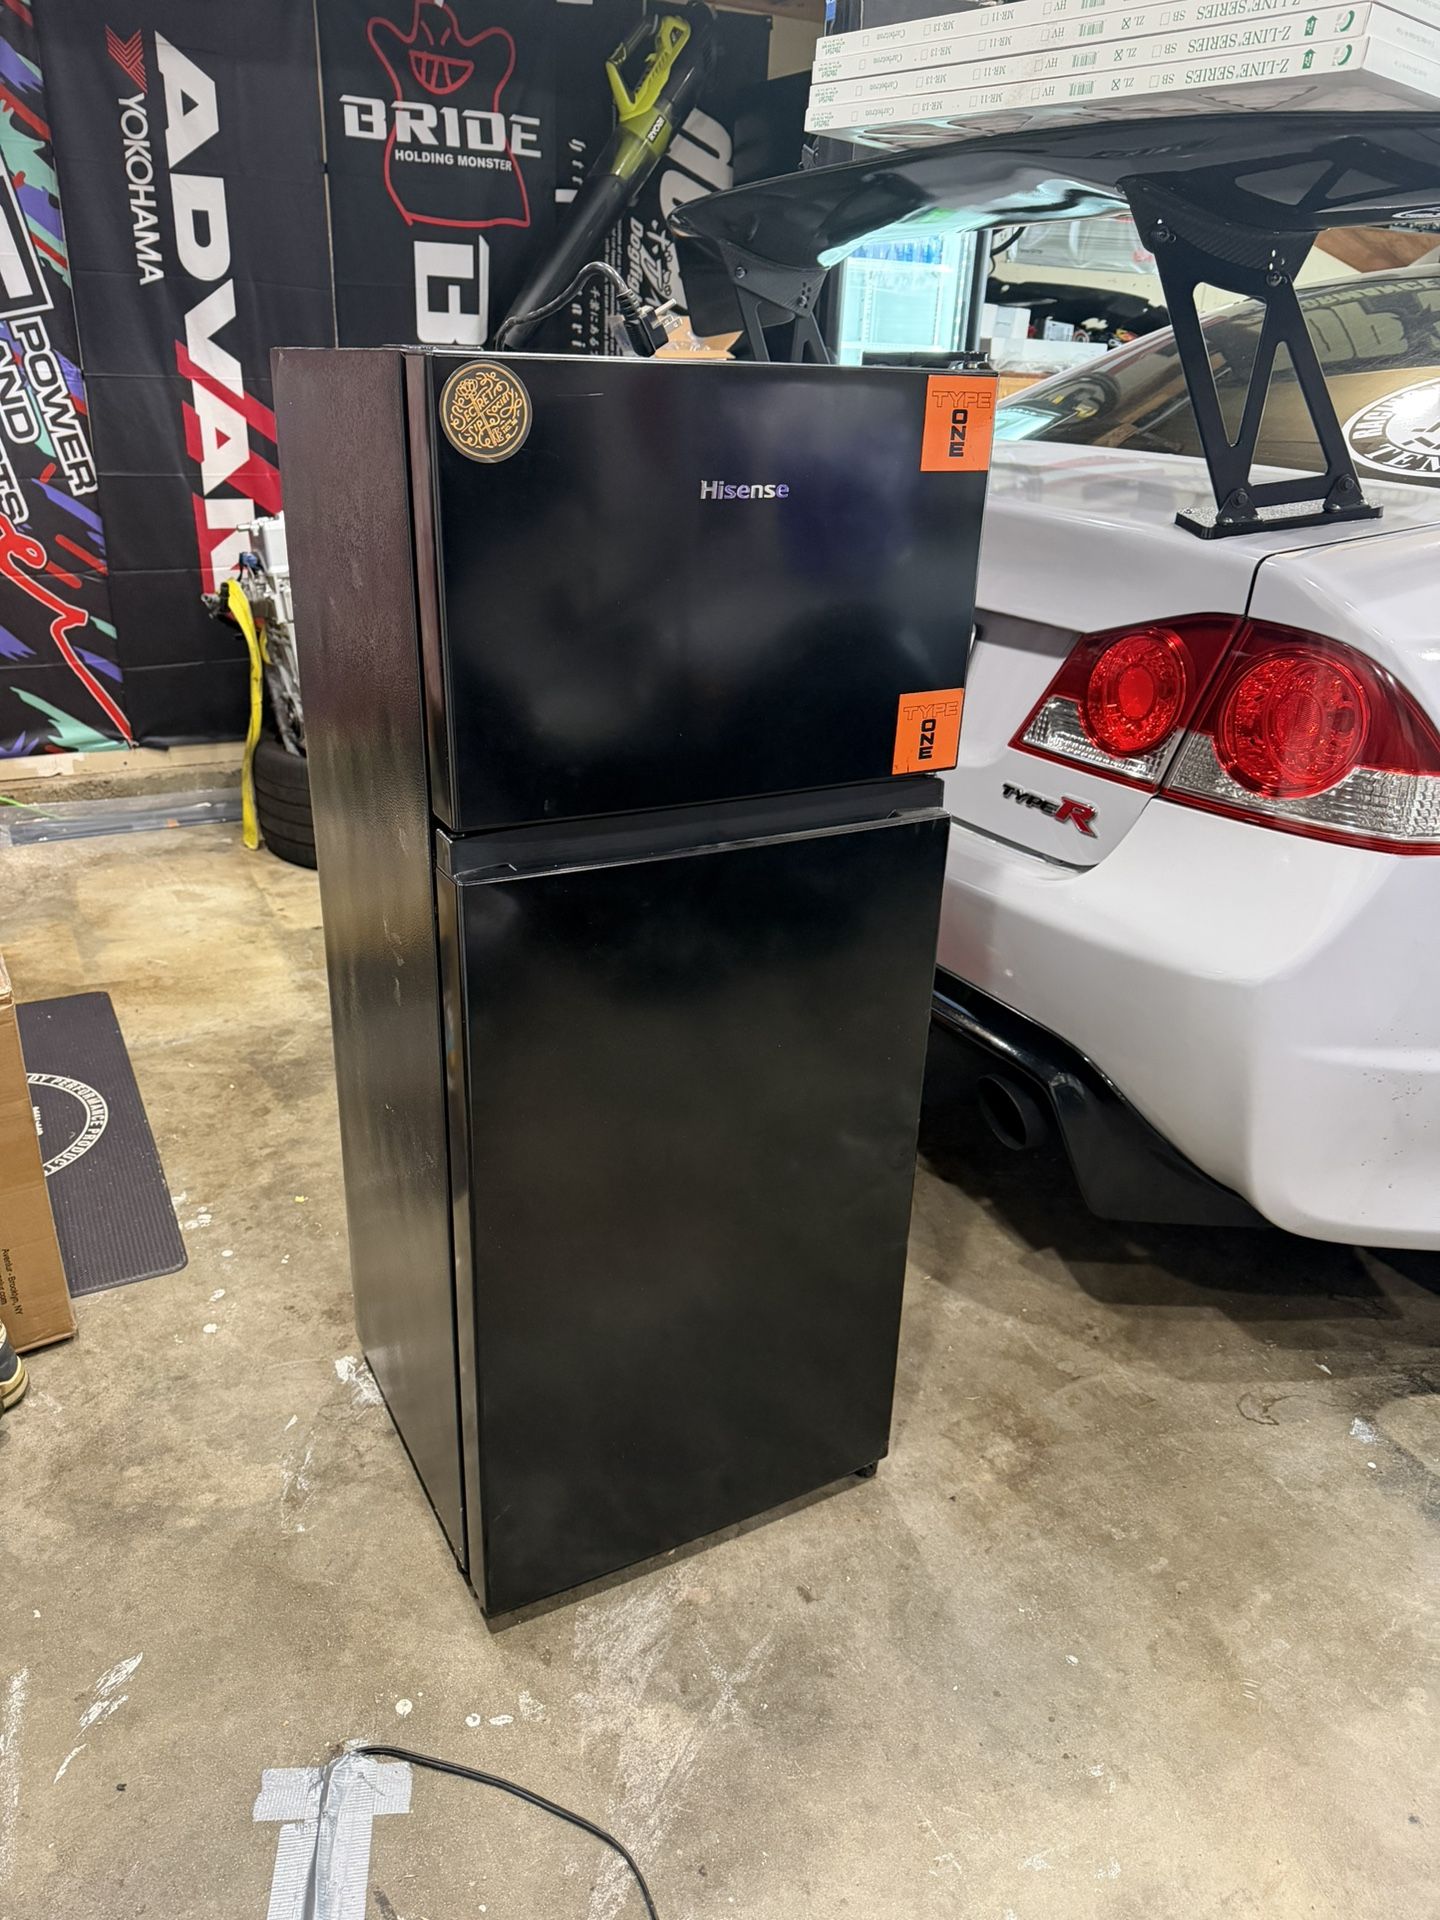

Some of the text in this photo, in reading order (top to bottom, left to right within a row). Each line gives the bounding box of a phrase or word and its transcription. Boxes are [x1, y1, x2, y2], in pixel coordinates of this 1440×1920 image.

[1051, 27, 1065, 39] HV
[1126, 47, 1138, 58] ZL
[1164, 42, 1178, 55] SB
[1044, 57, 1058, 69] HV
[1123, 77, 1135, 88] ZL
[1162, 73, 1175, 85] SB
[1042, 85, 1055, 97] HV
[339, 94, 542, 158] BRIDE
[395, 149, 513, 171] HOLDING MONSTER
[118, 93, 164, 285] YOKOHAMA
[12, 316, 99, 496] POWER
[932, 390, 992, 409] TYPE
[949, 409, 968, 457] ONE
[700, 480, 790, 499] Hisense
[903, 701, 959, 721] TYPE
[918, 718, 937, 760] ONE
[1002, 782, 1098, 839] TYPE R
